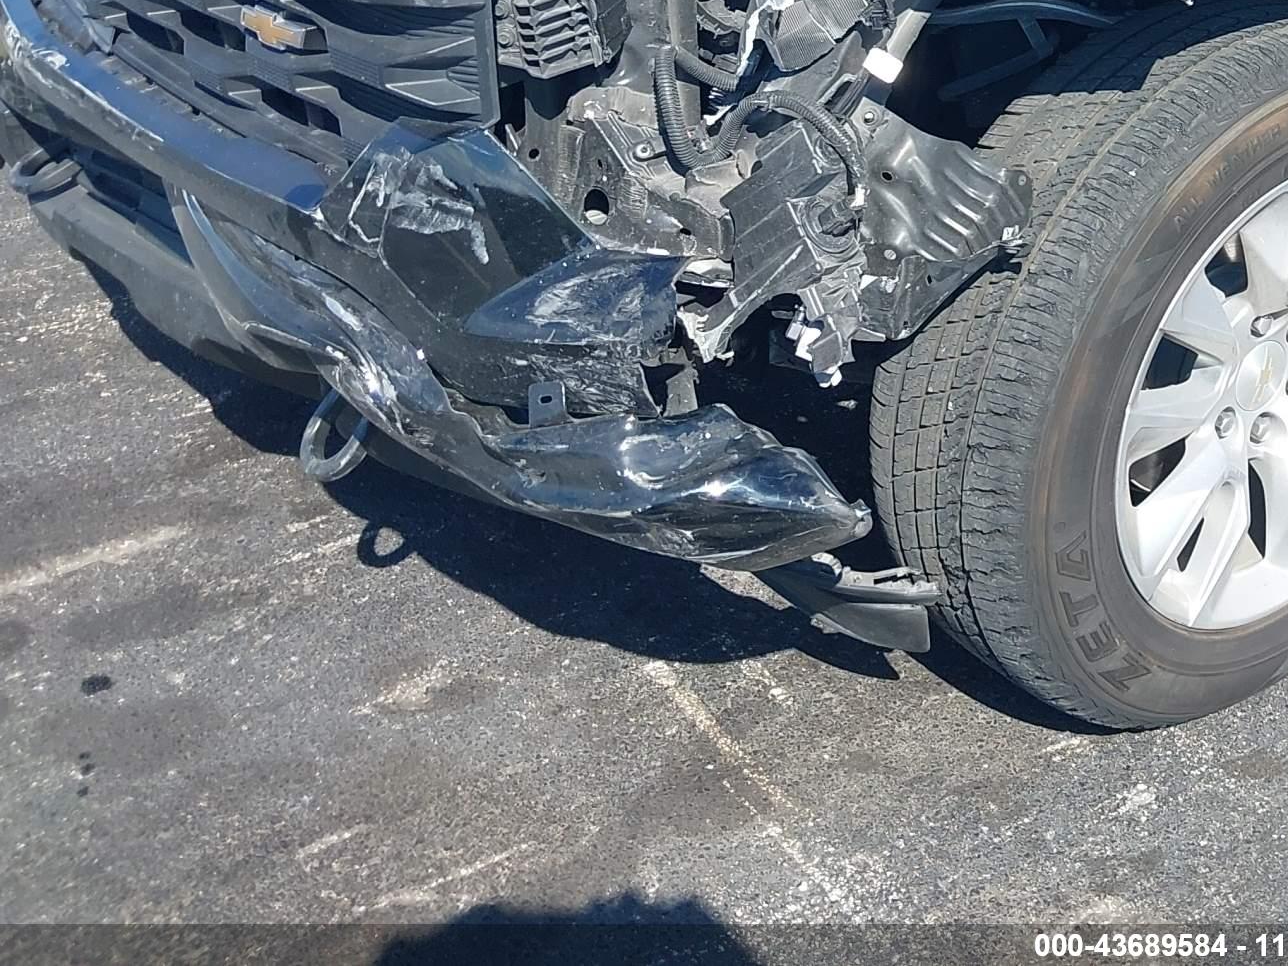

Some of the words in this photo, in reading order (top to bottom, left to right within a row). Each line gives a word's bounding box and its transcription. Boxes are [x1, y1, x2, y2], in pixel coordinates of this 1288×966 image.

[1174, 194, 1204, 233] ALL
[1205, 123, 1282, 189] WEATHER
[1055, 530, 1152, 694] ZETA
